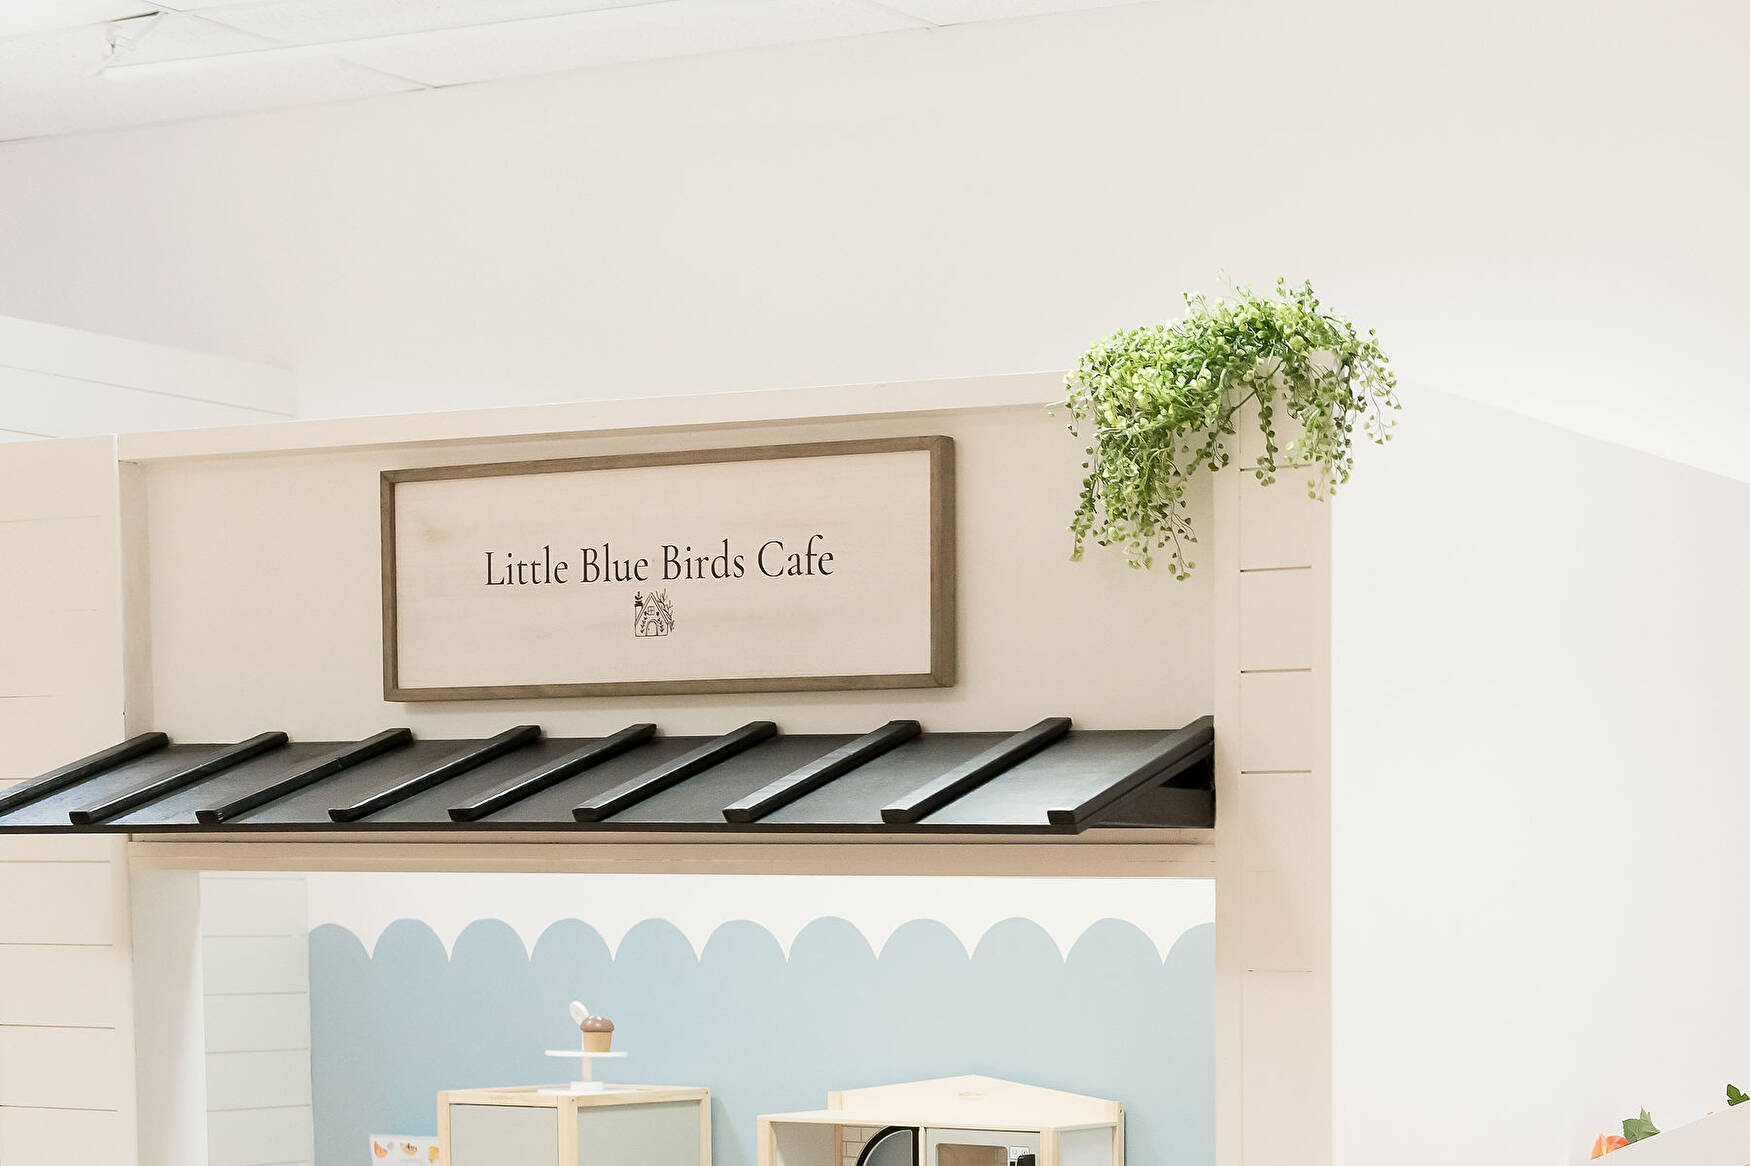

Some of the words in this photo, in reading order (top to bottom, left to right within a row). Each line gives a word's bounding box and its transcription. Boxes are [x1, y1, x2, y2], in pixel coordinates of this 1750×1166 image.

[485, 545, 569, 586] Little
[580, 544, 649, 583] Blue
[661, 539, 746, 581] Birds
[757, 534, 835, 577] Cafe
